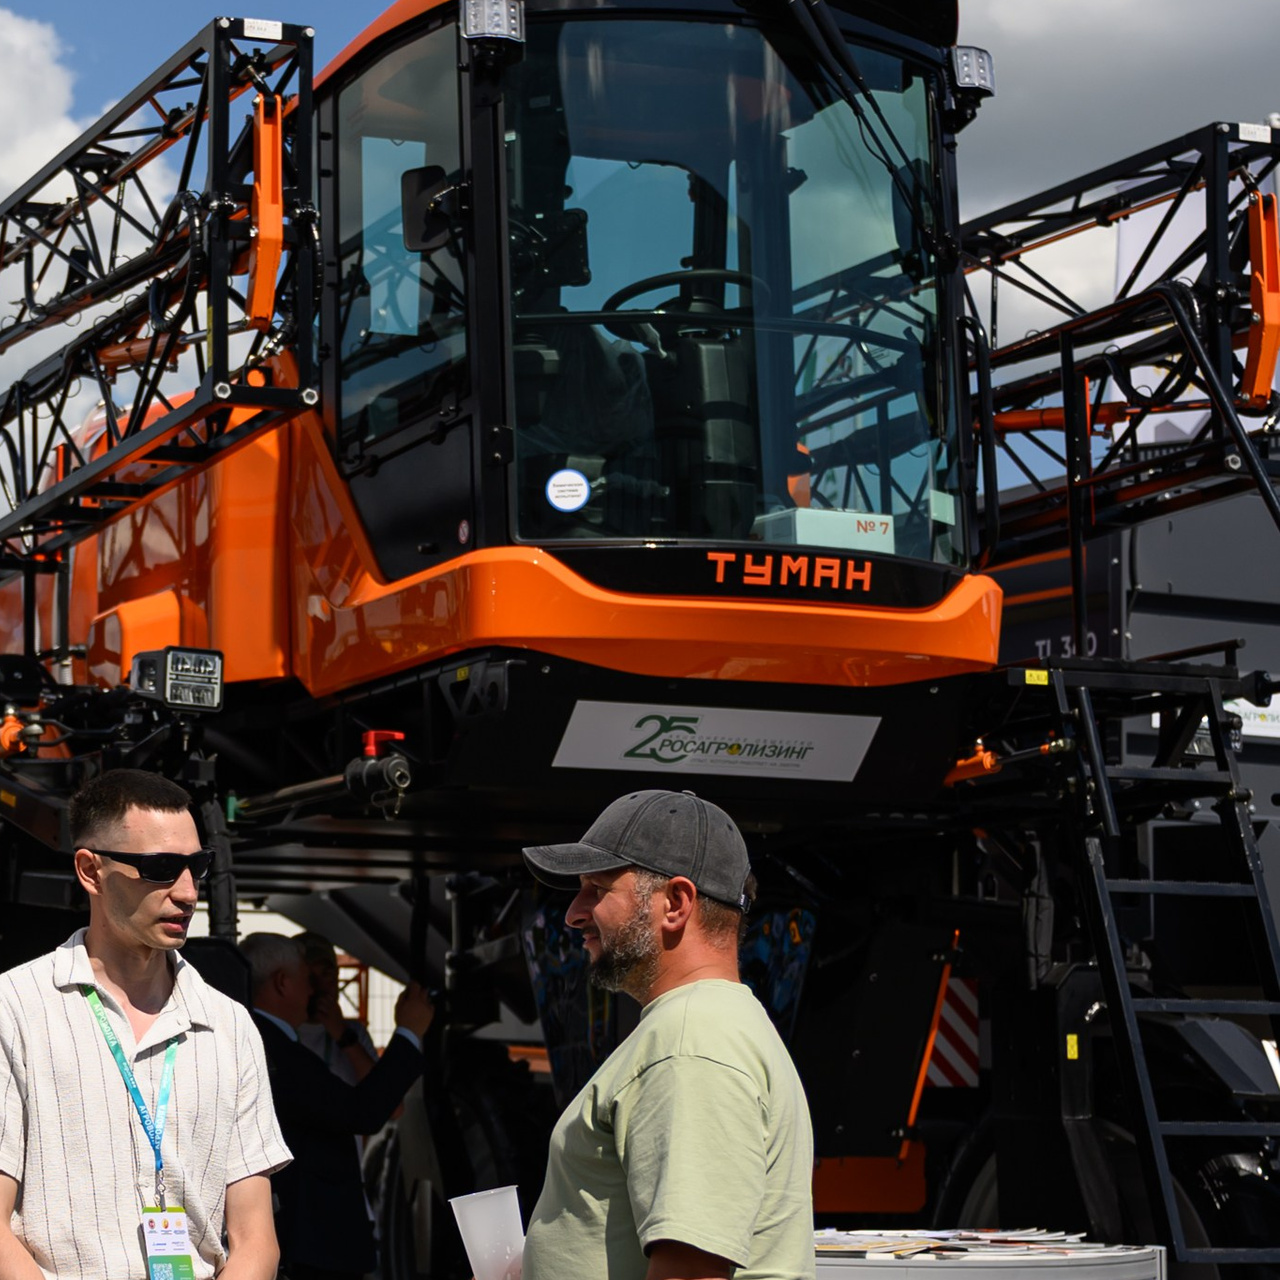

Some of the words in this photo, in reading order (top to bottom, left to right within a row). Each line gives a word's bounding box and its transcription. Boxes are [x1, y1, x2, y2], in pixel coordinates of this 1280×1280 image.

[856, 520, 876, 534] №
[880, 521, 889, 535] 7
[707, 552, 872, 592] ТУМАН
[658, 738, 815, 760] РОСАГРОЛИЗИНГ
